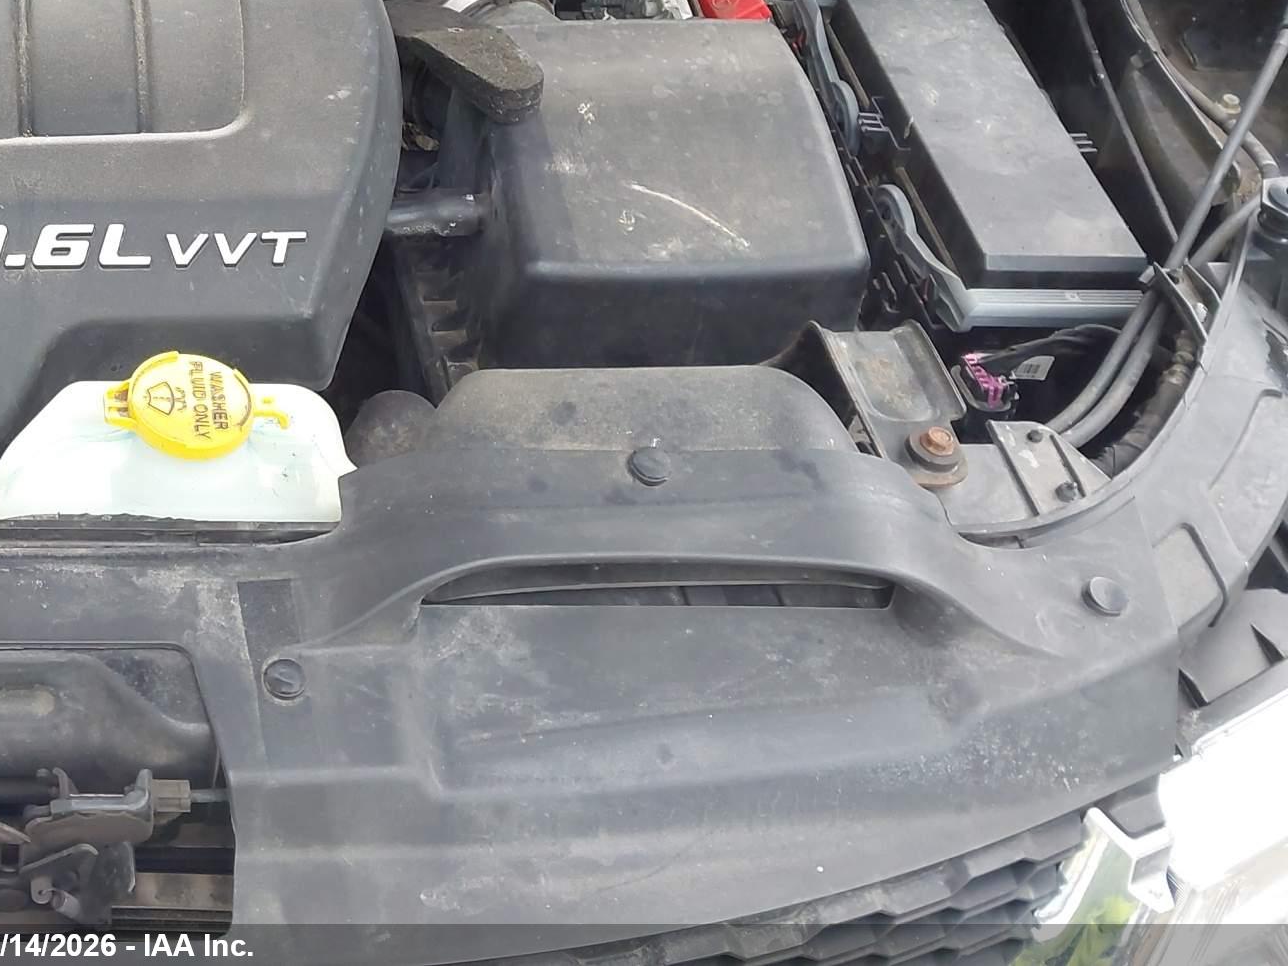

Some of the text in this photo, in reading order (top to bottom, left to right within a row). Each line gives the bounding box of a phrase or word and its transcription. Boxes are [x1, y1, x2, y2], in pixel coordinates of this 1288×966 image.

[165, 230, 307, 268] VVT
[188, 361, 212, 440] FLUID ONLY
[209, 371, 229, 430] WASHER
